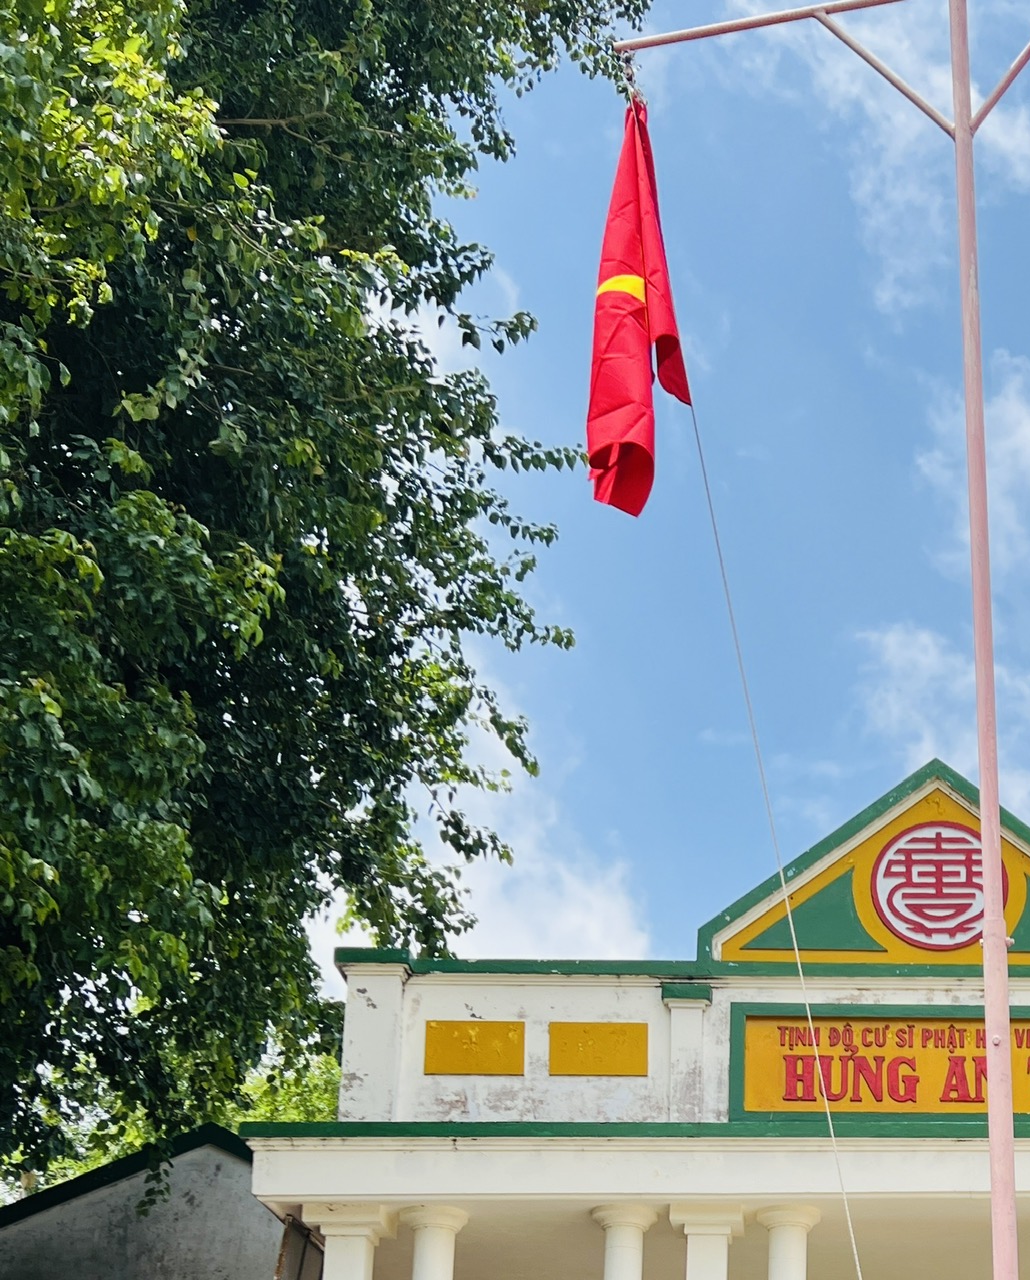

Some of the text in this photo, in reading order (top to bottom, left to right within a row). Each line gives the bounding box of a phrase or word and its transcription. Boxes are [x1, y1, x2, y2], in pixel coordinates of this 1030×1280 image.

[777, 1025, 820, 1051] TỊNH
[828, 1022, 854, 1052] ĐỘ
[862, 1024, 890, 1048] CƯ
[895, 1024, 915, 1048] SĨ
[921, 1024, 967, 1054] PHẬT
